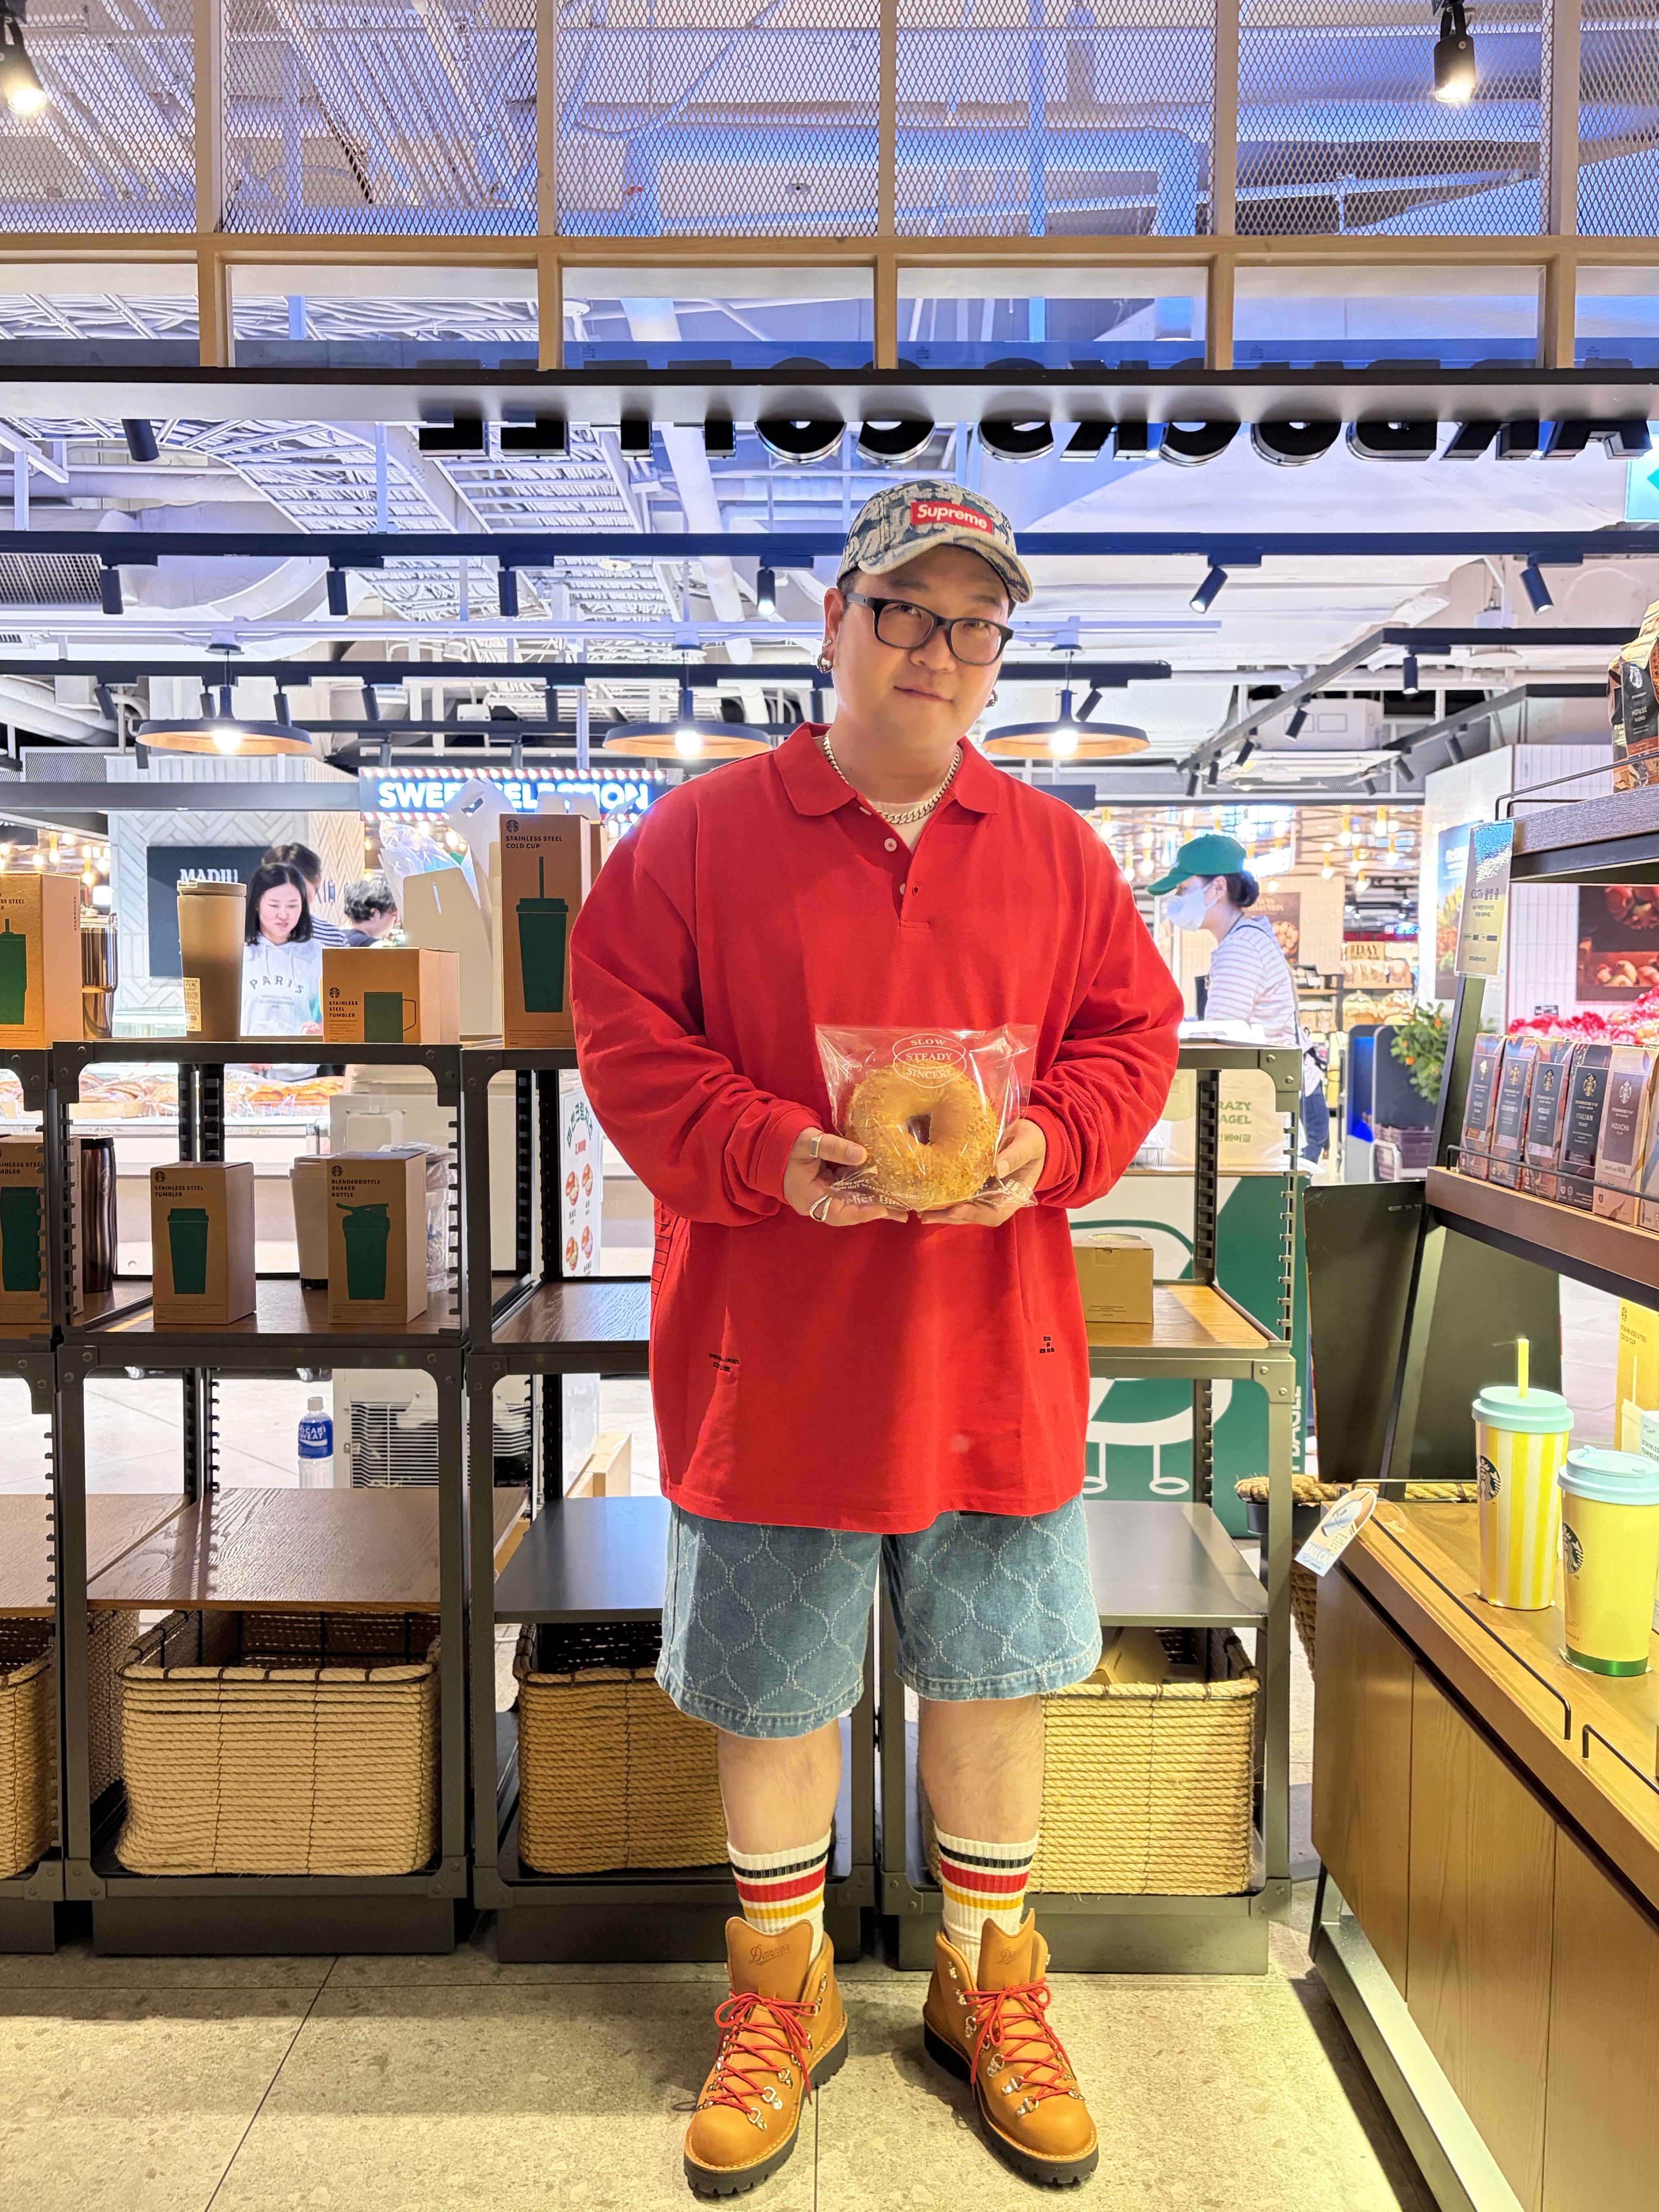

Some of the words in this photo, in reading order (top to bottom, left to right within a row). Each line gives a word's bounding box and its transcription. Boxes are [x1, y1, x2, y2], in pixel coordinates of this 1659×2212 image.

[917, 503, 988, 529] Supreme
[1631, 706, 1648, 716] HOUSE
[379, 782, 463, 809] SWEE
[249, 975, 304, 993] PARIS
[906, 1053, 953, 1061] STEADY
[906, 1066, 955, 1079] SINCERE
[1576, 1112, 1593, 1121] ITALIAN
[1621, 1325, 1637, 1338] STAINLESS
[1637, 1333, 1647, 1343] STEEL
[1621, 1333, 1629, 1342] COLD
[1642, 1447, 1659, 1463] TUMBLER
[1303, 1542, 1321, 1559] BALL
[1317, 1551, 1334, 1565] CAP
[748, 1943, 791, 1966] Danner
